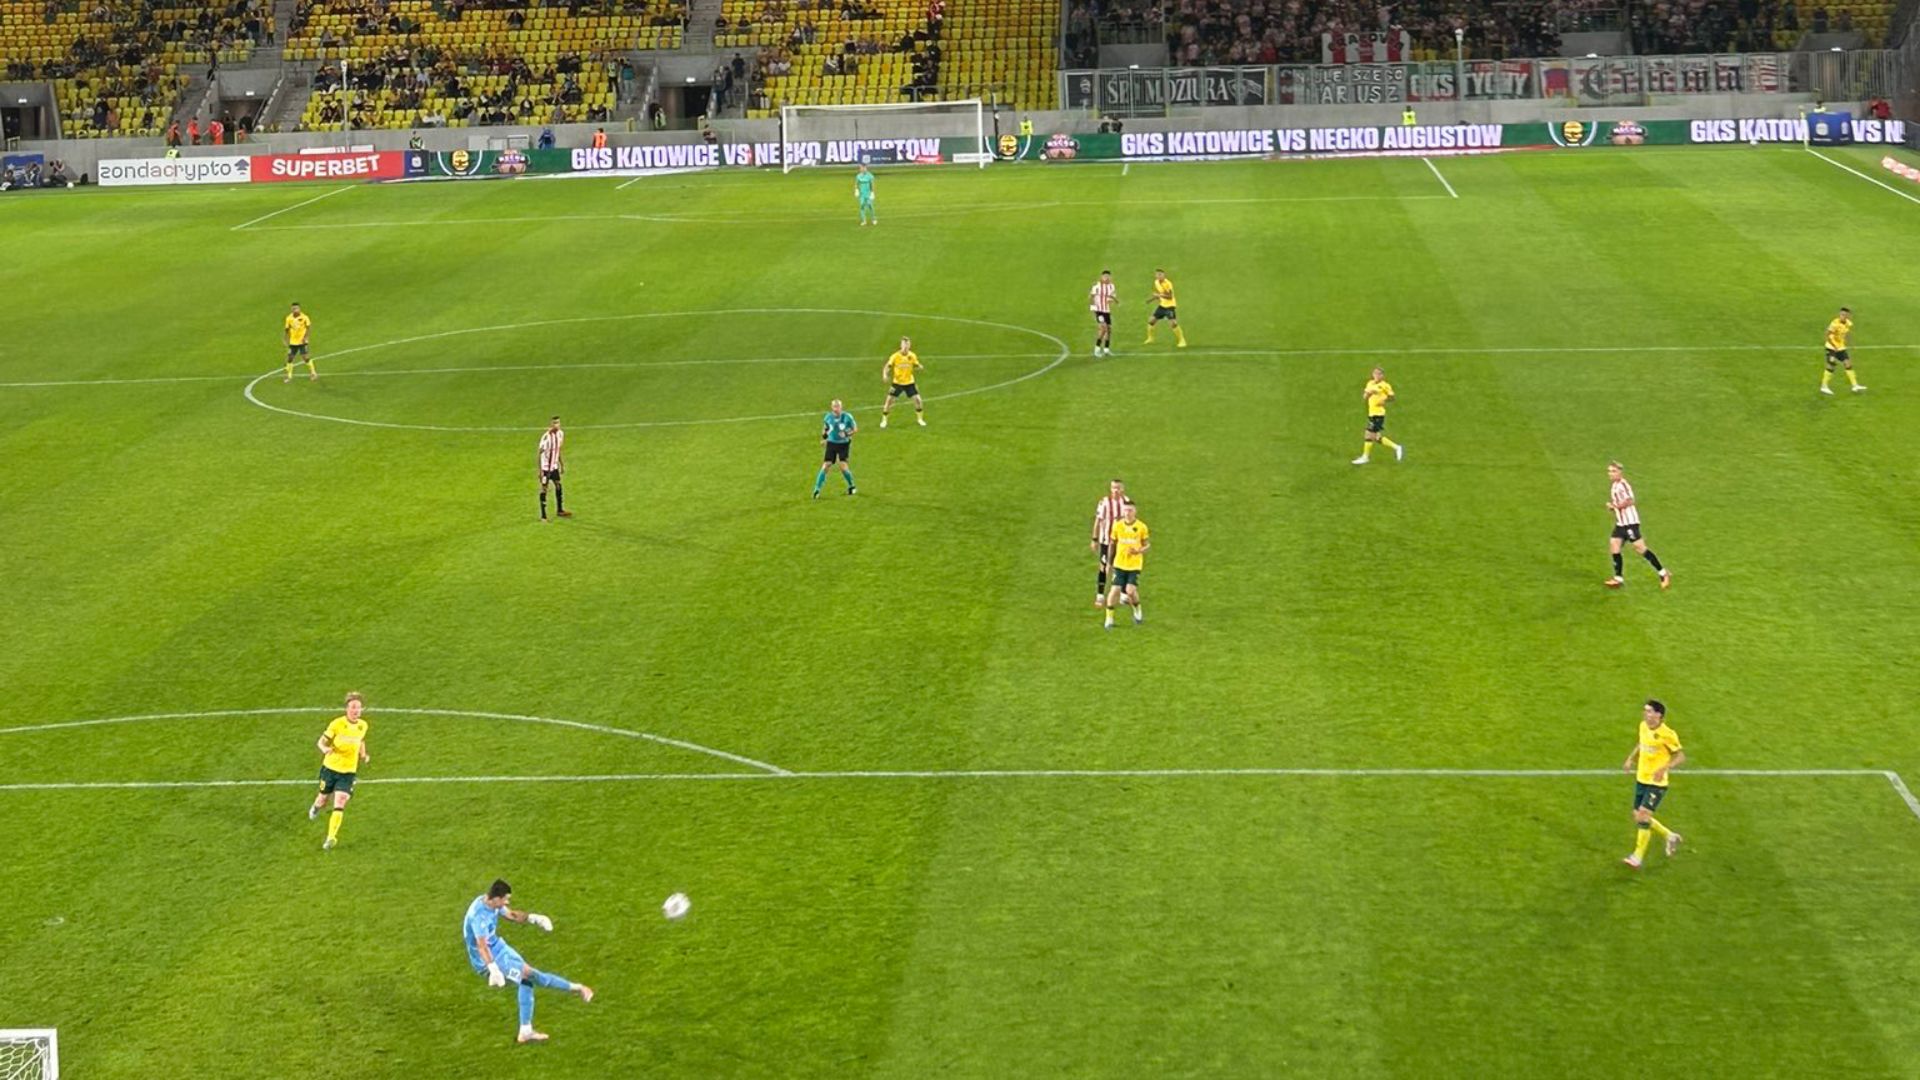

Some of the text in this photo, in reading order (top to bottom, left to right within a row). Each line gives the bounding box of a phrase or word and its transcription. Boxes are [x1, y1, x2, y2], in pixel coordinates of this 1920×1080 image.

[1121, 124, 1503, 155] GKS KATOWICE VS NECKO AUGUSTOW
[1690, 119, 1736, 143] GKS
[1851, 120, 1882, 143] VS
[272, 154, 380, 177] SUPERBET
[571, 148, 613, 170] GKS
[617, 144, 719, 169] KATOWICE
[723, 143, 751, 166] VS
[100, 160, 232, 181] zondacrypto
